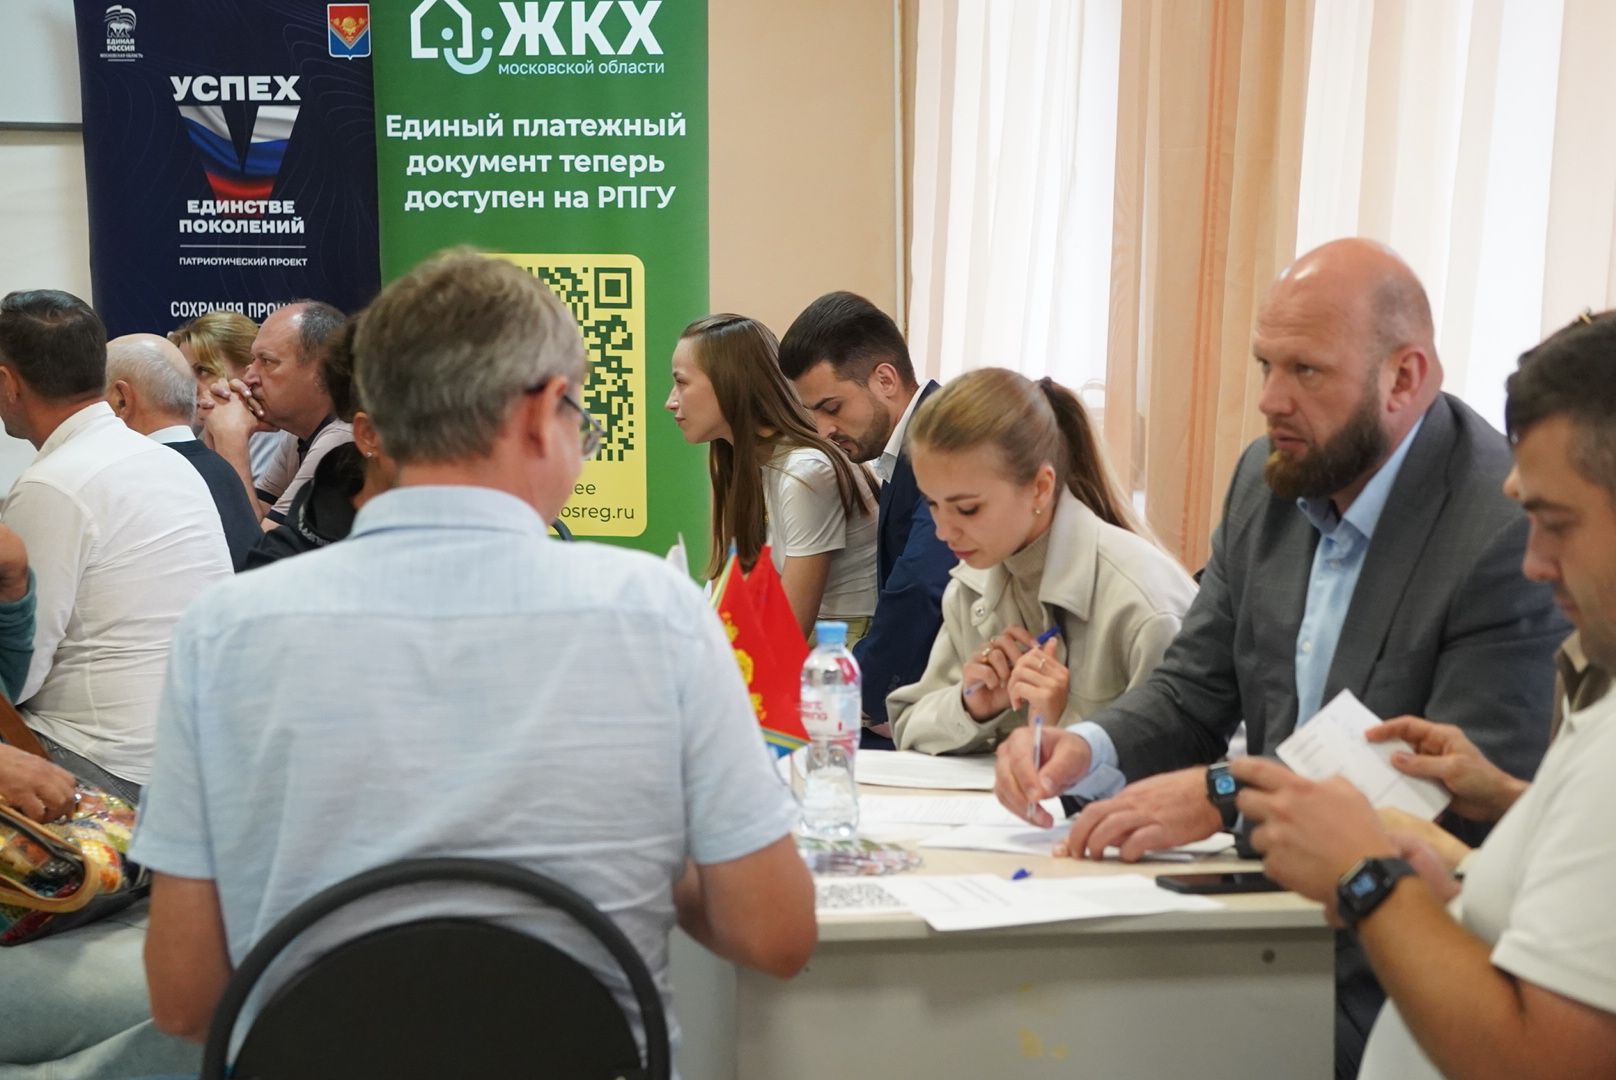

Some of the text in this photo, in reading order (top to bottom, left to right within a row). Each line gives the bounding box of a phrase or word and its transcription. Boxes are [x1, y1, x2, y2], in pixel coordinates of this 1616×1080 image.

[498, 0, 664, 56] ЖКХ
[498, 60, 665, 75] московской области
[169, 75, 301, 101] УСПЕХ
[386, 112, 687, 140] Единый платежный
[406, 154, 665, 178] документ теперь
[187, 200, 295, 216] ЕДИНСТВЕ
[404, 186, 677, 214] доступен на РПГУ
[179, 217, 305, 234] ПОКОЛЕНИЙ
[179, 256, 308, 266] ПАТРИОТИЧЕСКИЙ ПРОЕКТ
[572, 483, 596, 495] ее
[558, 506, 634, 522] osreg.ru
